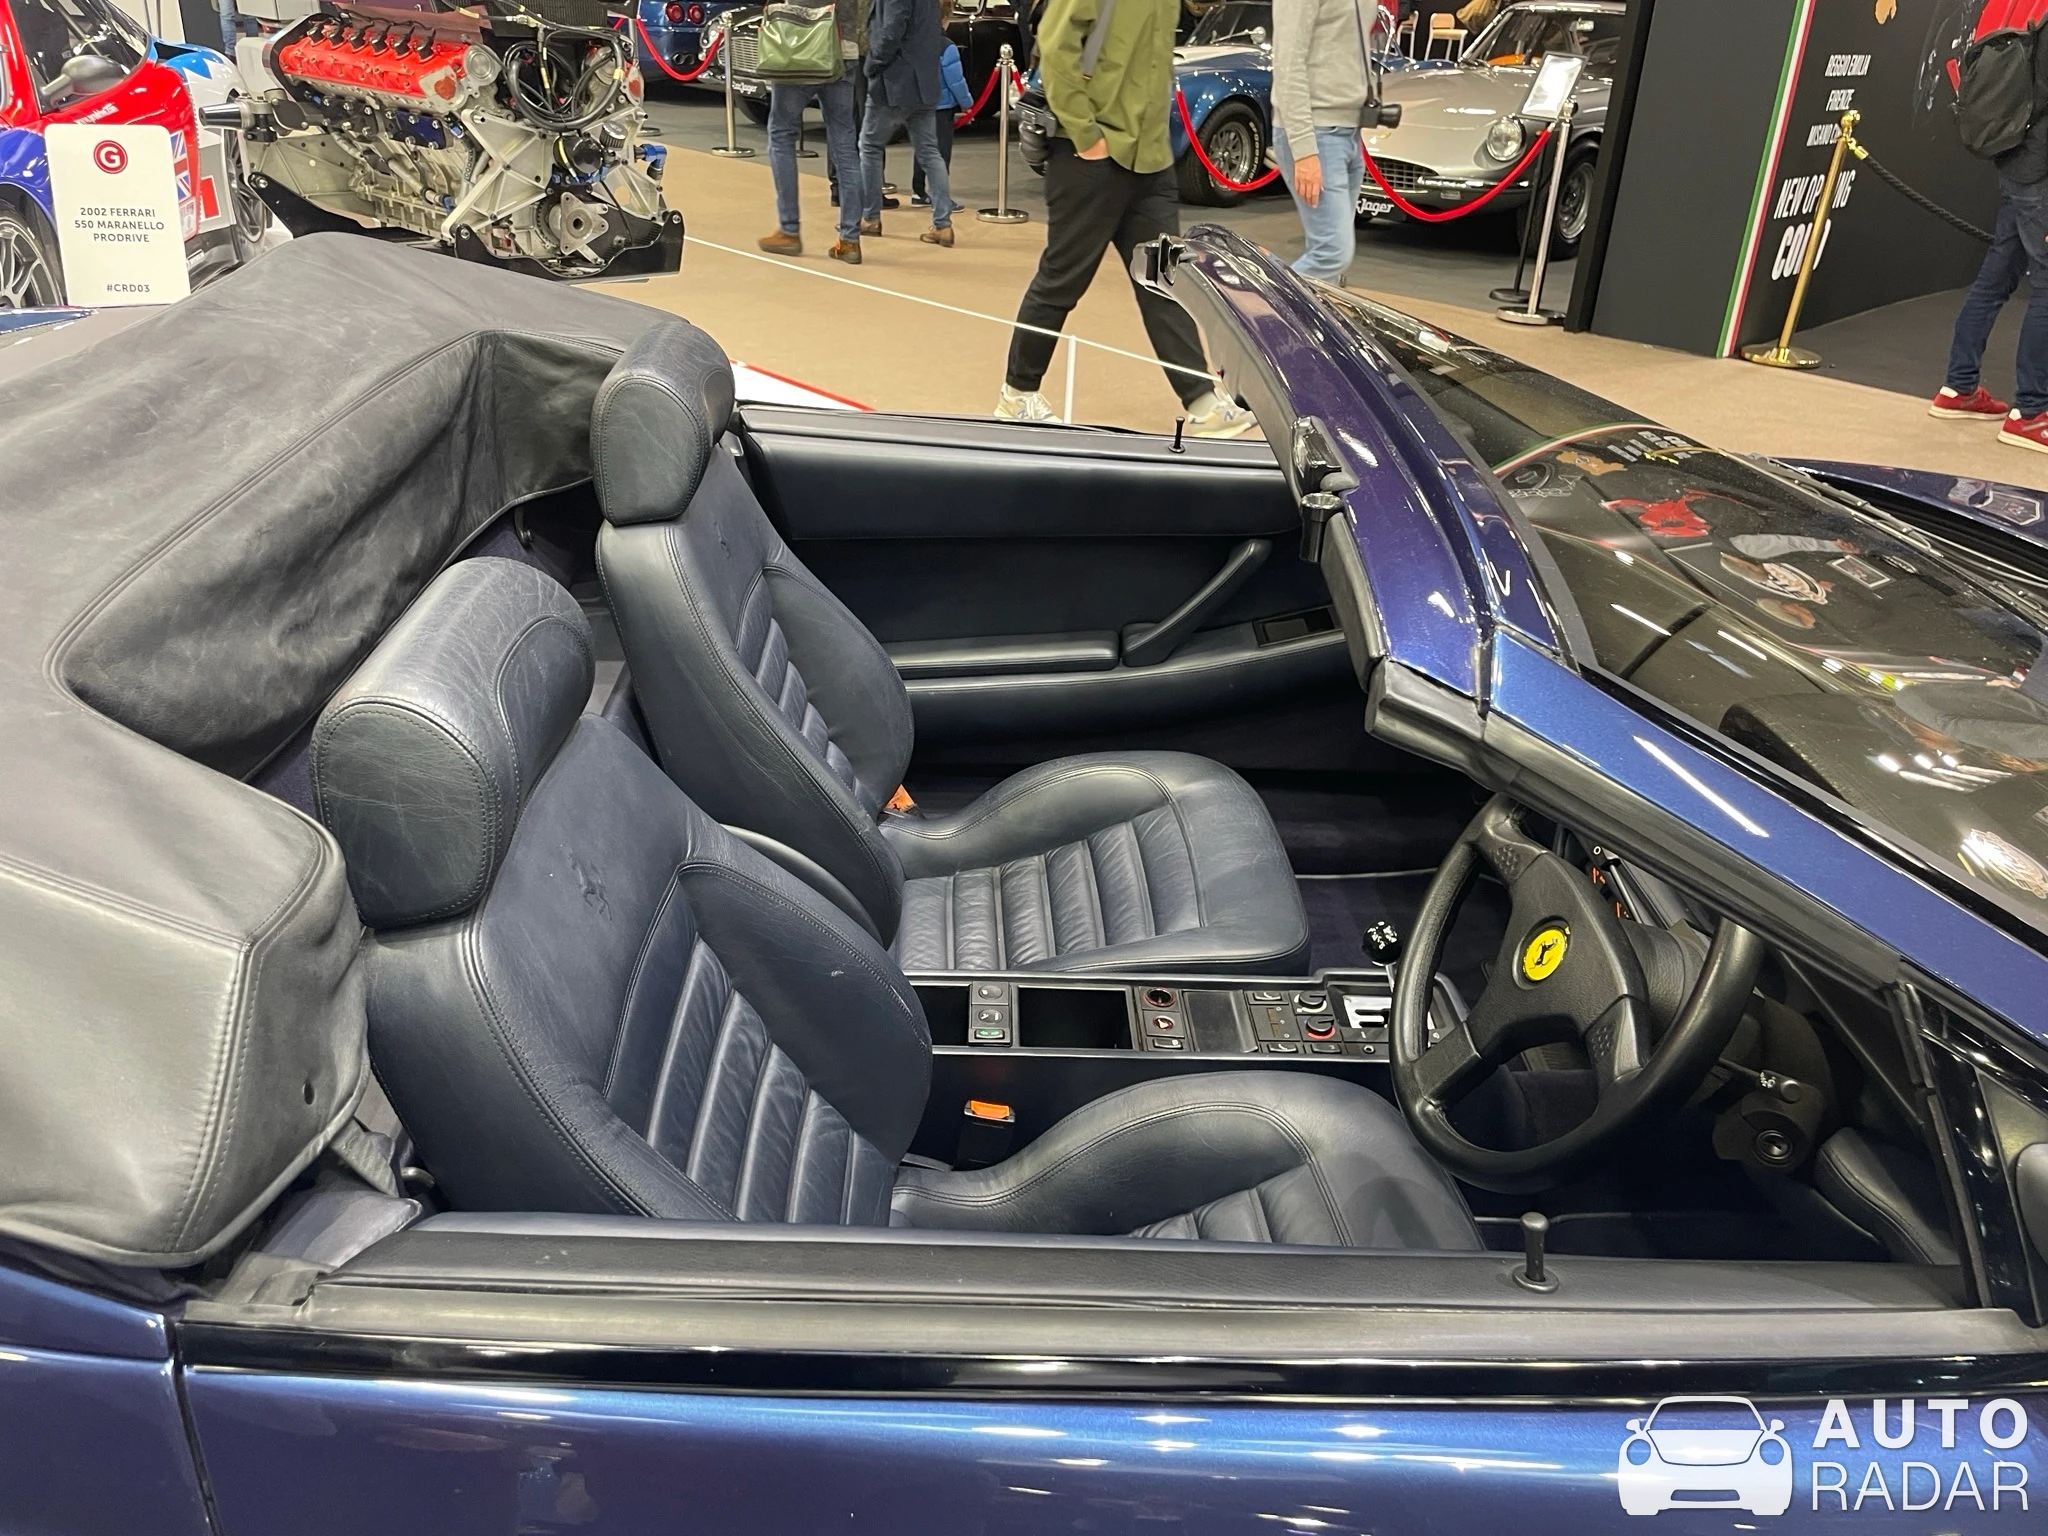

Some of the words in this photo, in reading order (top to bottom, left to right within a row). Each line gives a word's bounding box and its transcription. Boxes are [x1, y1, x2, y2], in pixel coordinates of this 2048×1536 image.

[99, 146, 121, 169] G
[1773, 176, 1810, 220] NEW
[1802, 169, 1856, 215] OPING
[80, 207, 107, 216] 2002
[110, 207, 156, 218] FERRARI
[74, 219, 94, 229] 550
[97, 220, 165, 231] MARANELLO
[93, 232, 150, 243] PRODRIVE
[106, 283, 151, 293] #CRD03
